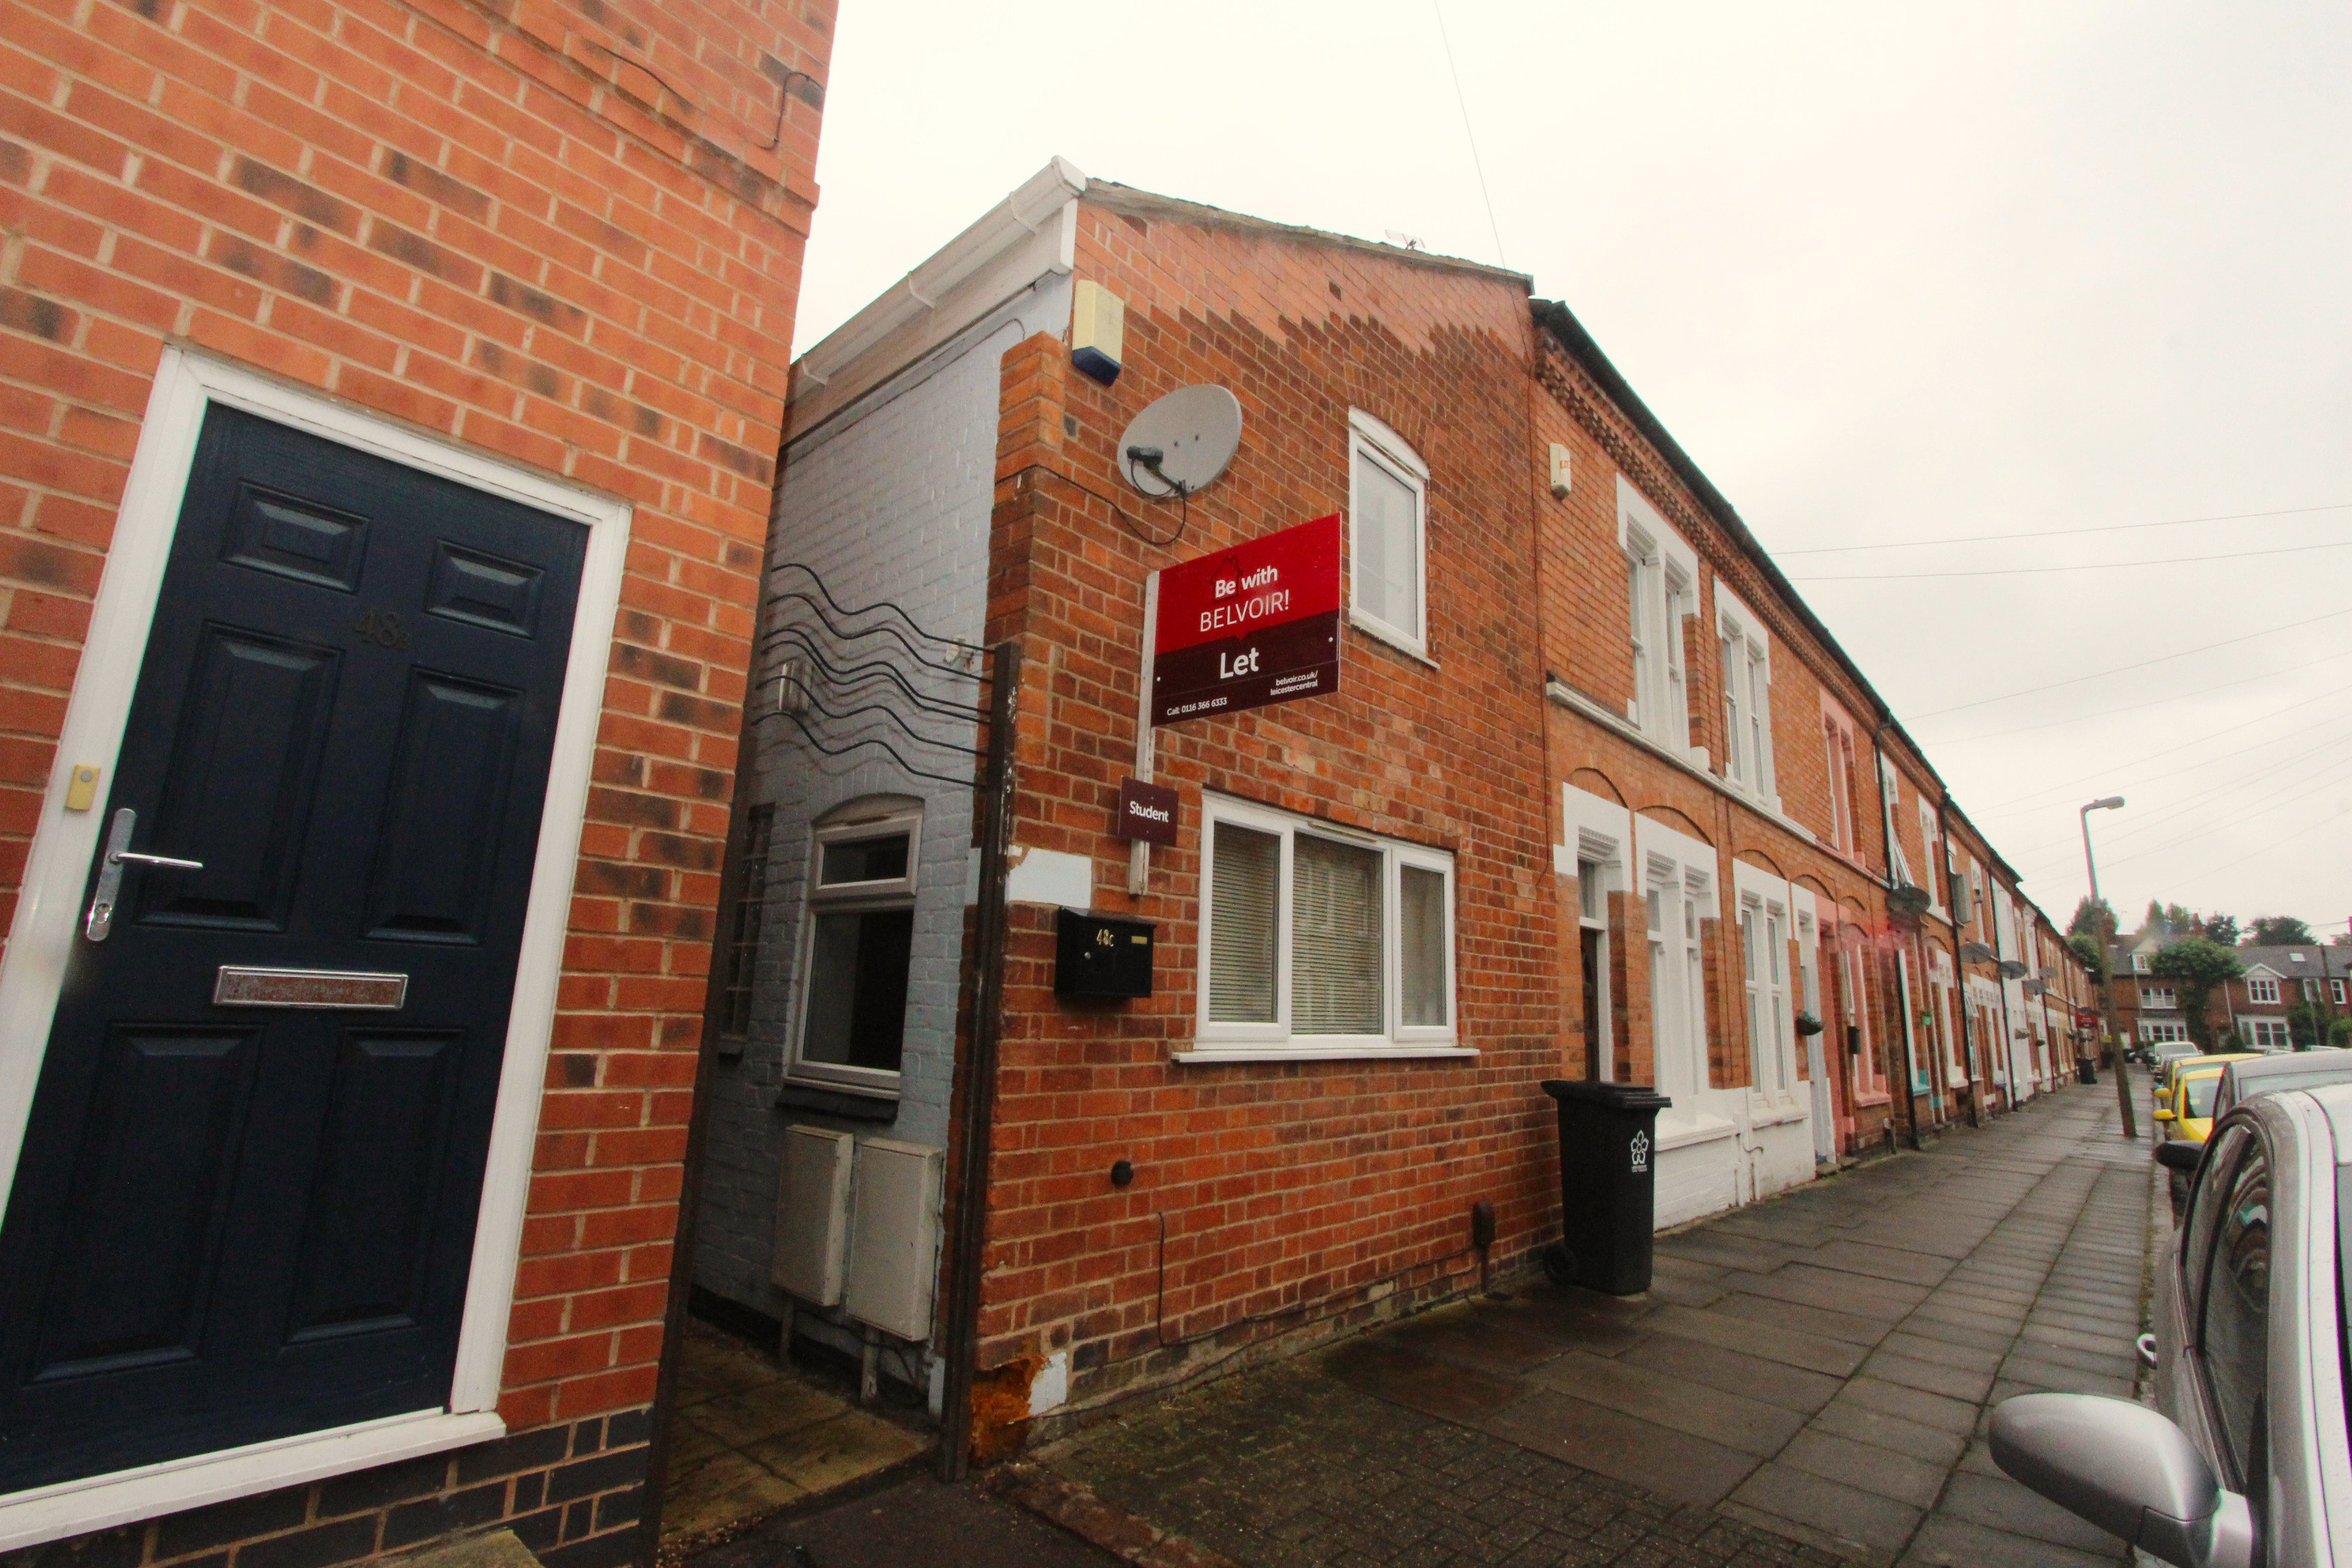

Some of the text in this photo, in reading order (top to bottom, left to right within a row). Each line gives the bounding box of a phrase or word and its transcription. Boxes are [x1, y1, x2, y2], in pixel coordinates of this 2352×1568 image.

[1215, 565, 1278, 598] Be with
[1200, 589, 1290, 632] BELVOIR!
[1220, 647, 1259, 679] Let
[1270, 679, 1318, 696] leicestercentral
[1275, 670, 1318, 686] belvoir.co.uk/
[1181, 703, 1196, 713] 0116
[1197, 700, 1210, 710] 366
[1211, 697, 1228, 708] 6333
[1129, 800, 1169, 823] Student
